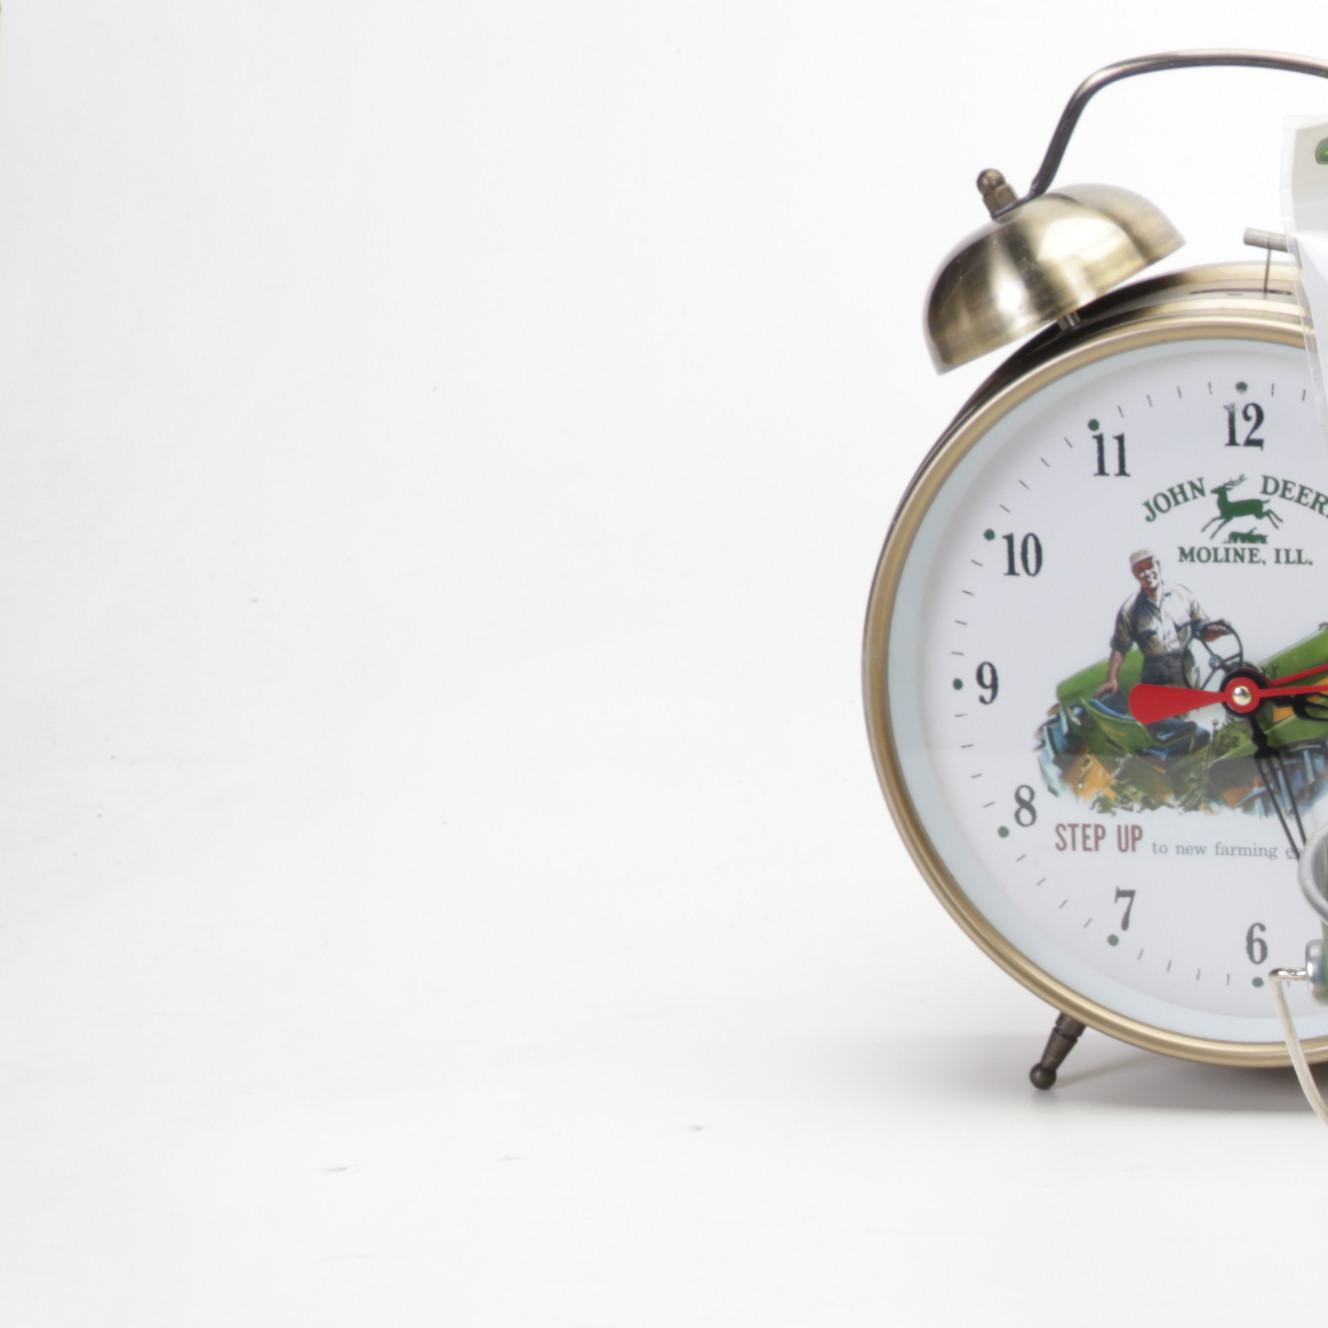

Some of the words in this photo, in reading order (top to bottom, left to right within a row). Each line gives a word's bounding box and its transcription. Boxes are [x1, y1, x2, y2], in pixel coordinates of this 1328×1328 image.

[1223, 403, 1264, 447] 12
[1092, 434, 1131, 476] 11
[1142, 477, 1206, 522] JOHN
[1002, 532, 1043, 576] 10
[1274, 548, 1313, 566] ILL.
[977, 661, 998, 704] 9
[1014, 784, 1038, 826] 8
[1055, 823, 1106, 852] STEP
[1117, 824, 1143, 852] UP
[1152, 841, 1168, 855] to
[1175, 843, 1207, 855] new
[1215, 841, 1278, 860] farming
[1113, 886, 1136, 929] 7
[1245, 923, 1268, 963] 6
